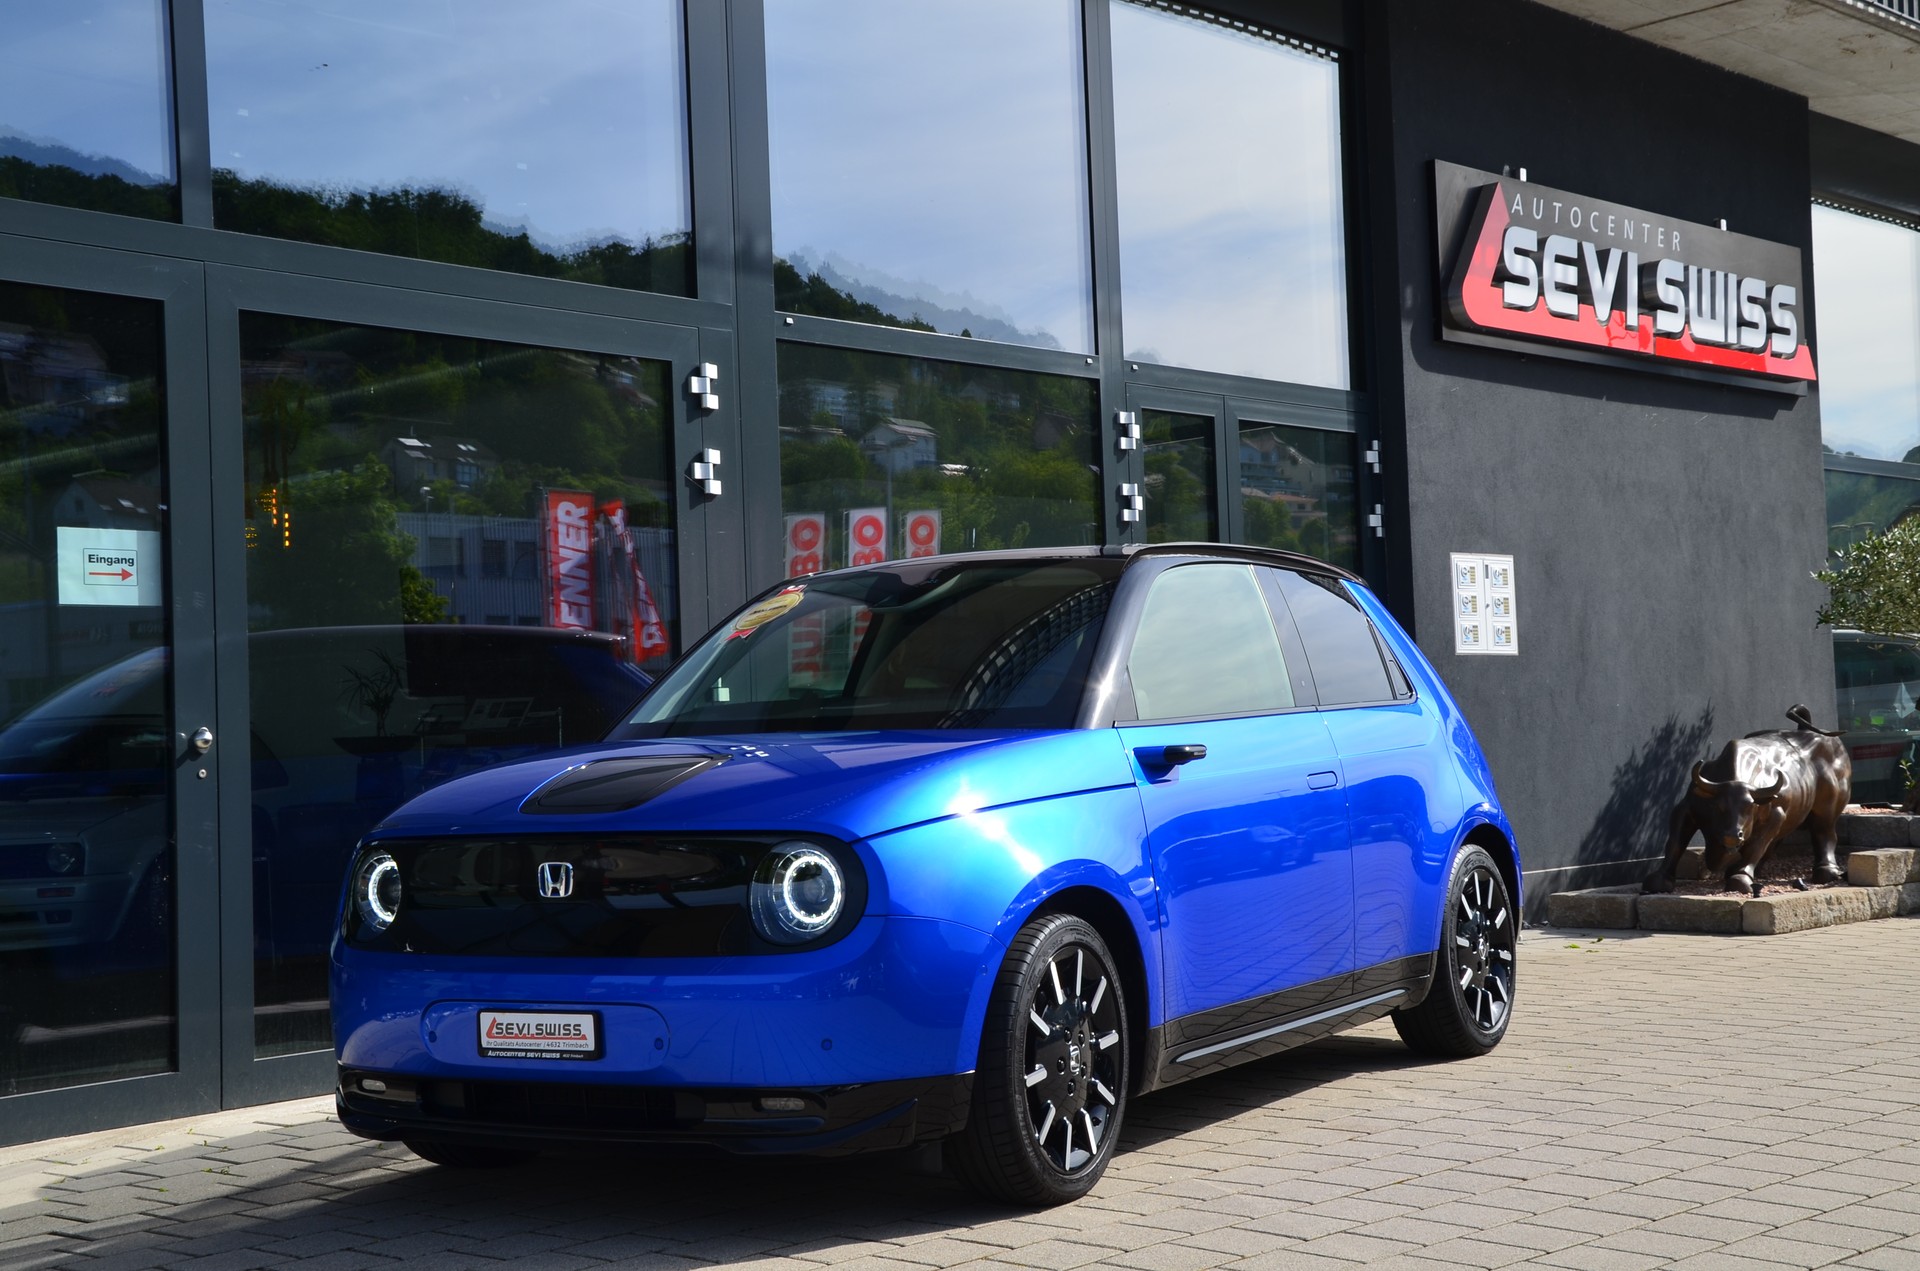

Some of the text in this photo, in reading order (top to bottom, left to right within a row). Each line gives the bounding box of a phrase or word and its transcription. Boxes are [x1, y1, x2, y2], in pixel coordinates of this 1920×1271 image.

[1510, 192, 1681, 252] AUTOCENTER
[1503, 226, 1798, 355] SEVI SWISS
[88, 554, 135, 567] Eingang
[557, 501, 592, 630] ENNER
[495, 1022, 582, 1037] SEVI SWISS
[562, 1041, 589, 1049] Trimbach
